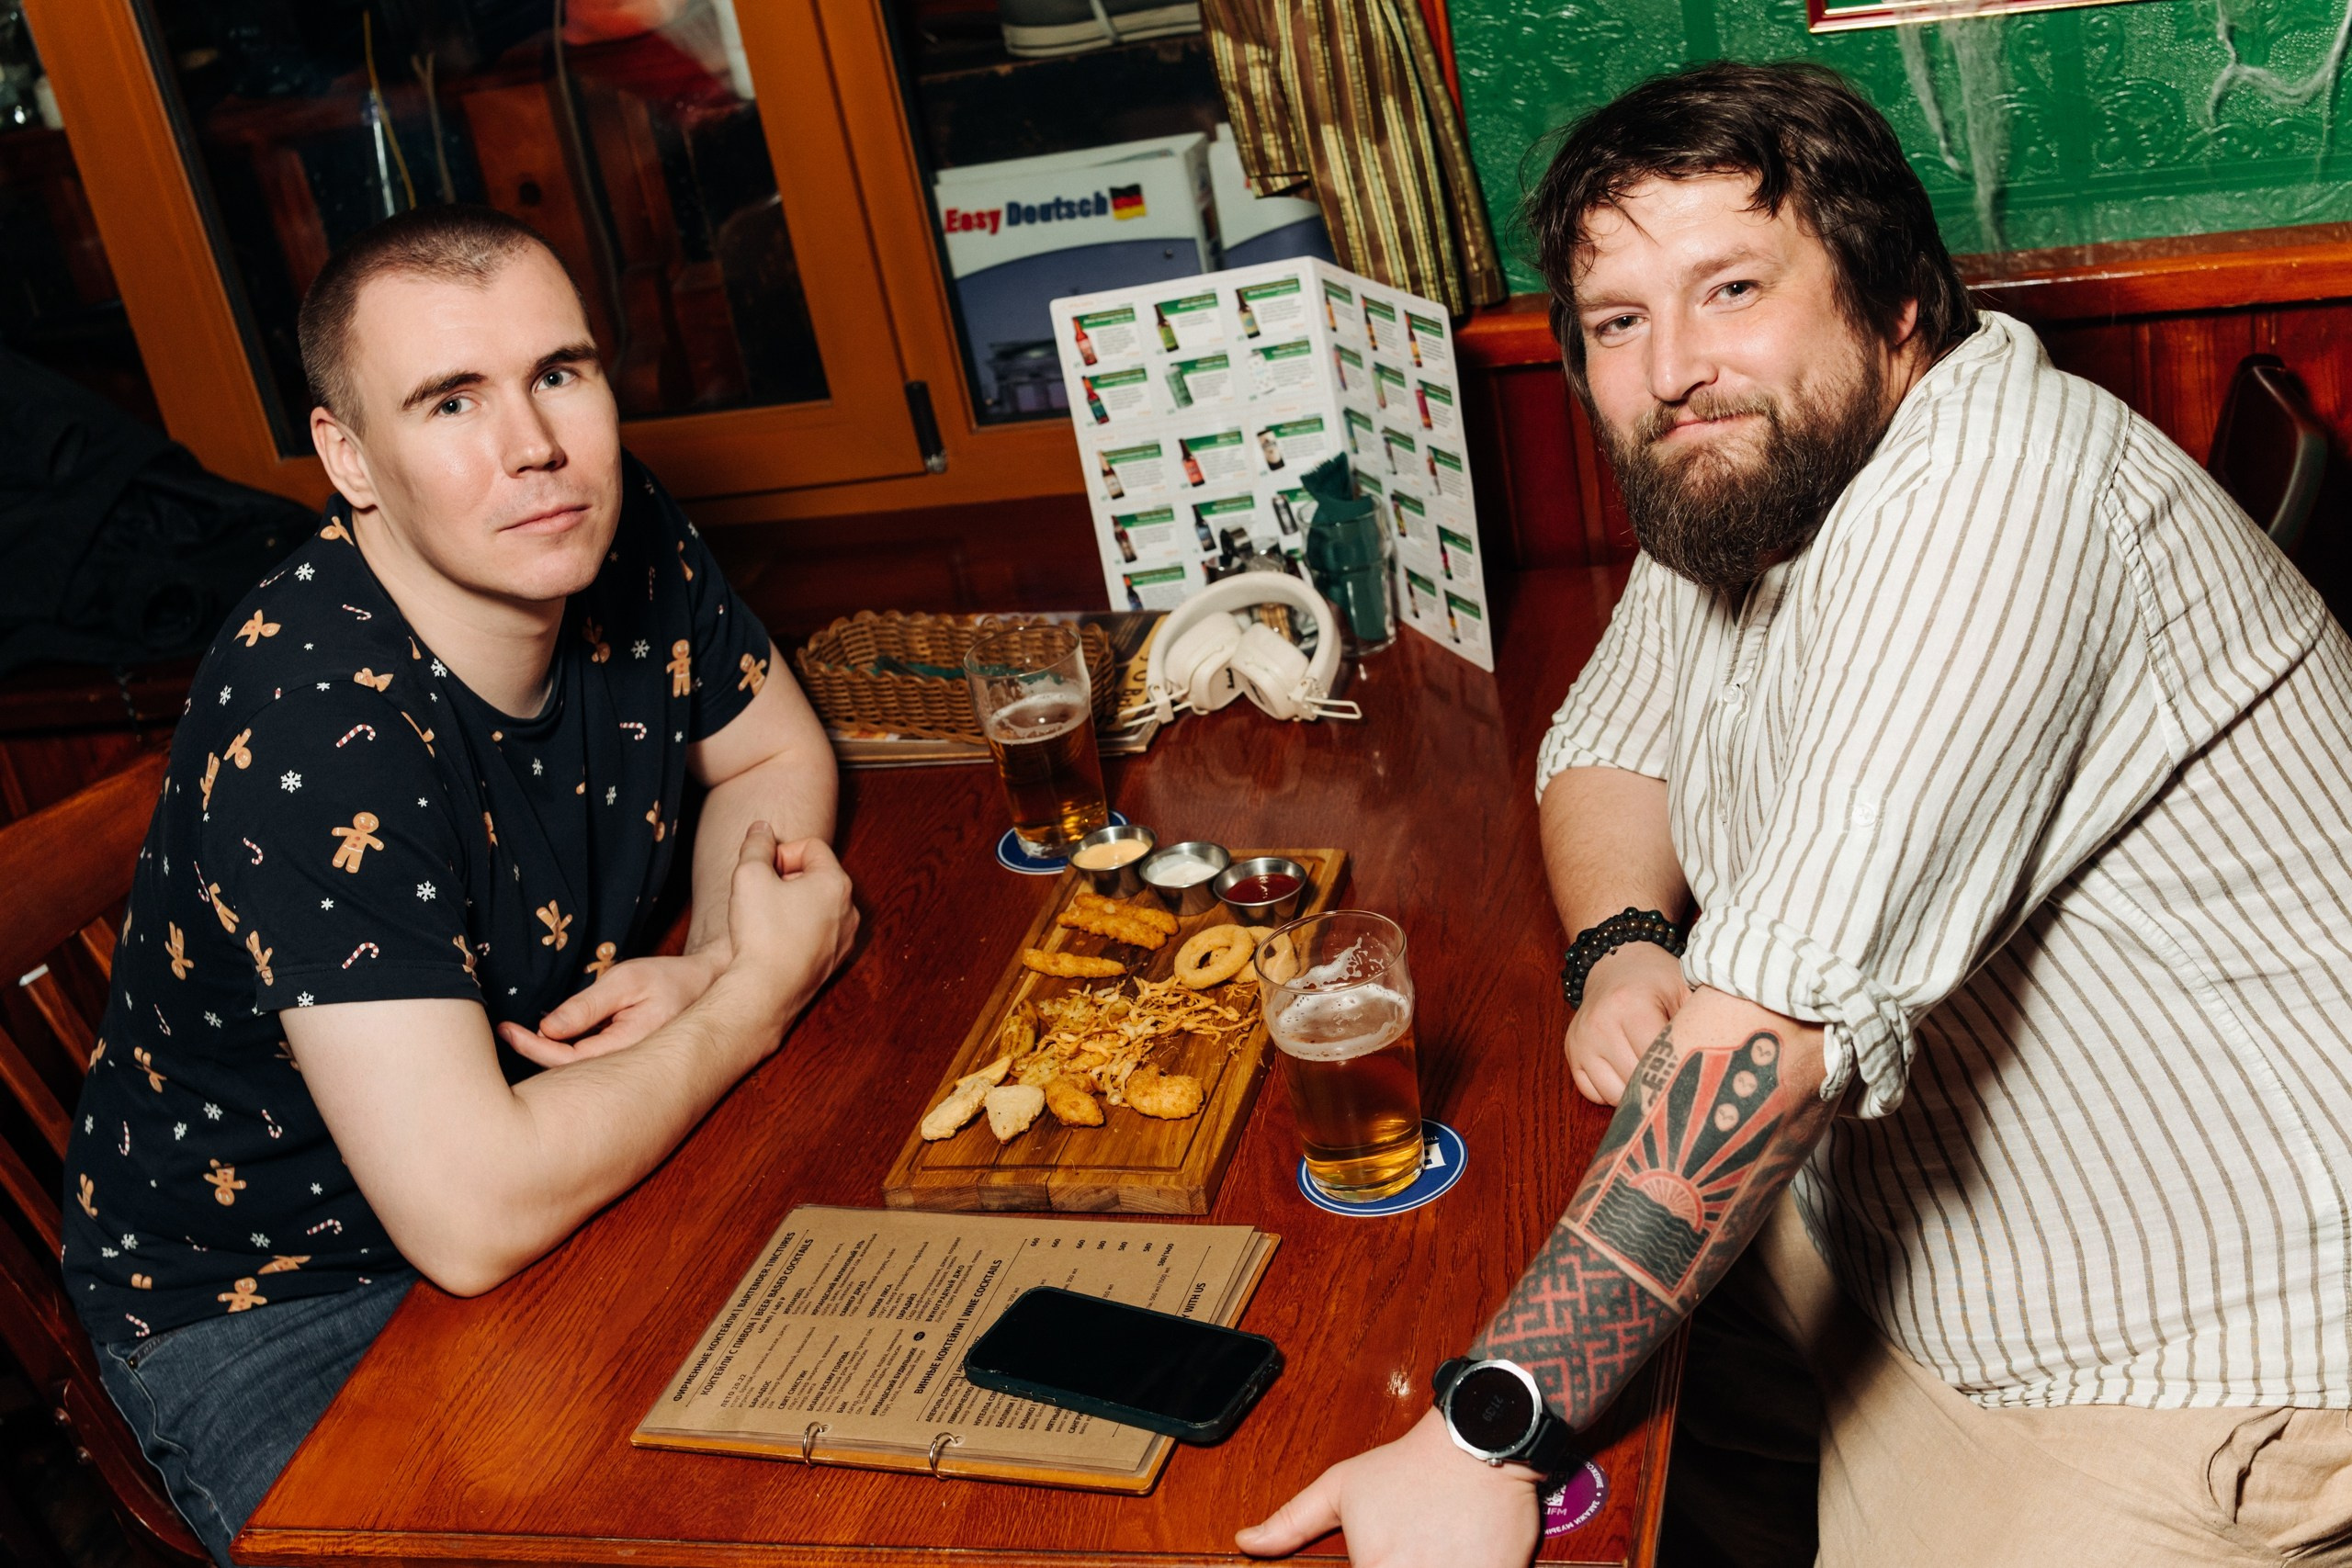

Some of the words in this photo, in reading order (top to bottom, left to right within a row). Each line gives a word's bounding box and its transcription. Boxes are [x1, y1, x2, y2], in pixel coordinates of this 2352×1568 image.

[945, 207, 1001, 235] Easy
[1006, 190, 1108, 227] Deutsch
[1029, 1237, 1041, 1247] 660
[1050, 1238, 1061, 1247] 660
[1075, 1239, 1086, 1248] 660
[1096, 1240, 1107, 1249] 580
[1117, 1241, 1128, 1250] 580
[1142, 1242, 1153, 1251] 580
[1156, 1243, 1175, 1266] 580/1400
[808, 1282, 838, 1315] ИРЛАНДСКИЙ
[831, 1250, 859, 1281] МАЛИНОВЫЙ
[854, 1239, 865, 1249] ЭЛЬ
[1065, 1274, 1075, 1282] 350
[782, 1287, 807, 1314] ИРЛАНДЕЦ
[838, 1295, 857, 1316] САММЕР
[852, 1280, 867, 1295] ДЖАЗ
[865, 1297, 885, 1317] ЧЕРНАЯ
[879, 1283, 894, 1297] ЛИСА
[894, 1292, 919, 1319] ПАРАДАЙЗ
[923, 1280, 957, 1321] ВИНОГРАДНЫЙ
[951, 1264, 966, 1278] ДЖО
[1006, 1293, 1016, 1302] 350
[1148, 1292, 1159, 1301] 560
[1182, 1294, 1201, 1313] WITH
[1193, 1282, 1206, 1292] US
[671, 1352, 712, 1401] ФИРМЕННЫЕ
[705, 1313, 740, 1350] КОКТЕЙЛИ
[736, 1268, 771, 1307] BARTENDER
[763, 1232, 797, 1267] TINCTURES
[698, 1355, 734, 1394] КОКТЕЙЛИ
[731, 1321, 757, 1348] ПИВОМ
[753, 1299, 773, 1315] BEER
[766, 1275, 789, 1297] BASED
[782, 1238, 814, 1274] COCKTAILS
[756, 1324, 768, 1333] 400
[772, 1301, 784, 1310] 480
[912, 1362, 941, 1393] ВИННЫЕ
[932, 1322, 966, 1360] КОКТЕЙЛИ
[961, 1298, 979, 1316] WINE
[972, 1259, 1003, 1297] COCKTAILS
[718, 1391, 735, 1406] ЛЕТО
[730, 1373, 747, 1389] 20.22
[776, 1395, 791, 1409] СВИТ
[786, 1370, 808, 1394] СИКСТИН
[806, 1391, 824, 1411] БЛАНШ
[819, 1372, 836, 1390] ВСЕМУ
[831, 1350, 851, 1371] ГОЛОВА
[868, 1379, 899, 1416] ИРЛАНДСКИЙ
[892, 1347, 919, 1379] БУДИЛЬНИК
[835, 1401, 849, 1413] БЫК
[924, 1397, 945, 1422] АПЕРОЛЬ
[939, 1375, 959, 1396] СПРИТЦ
[972, 1401, 993, 1426] НУТЕЛЛА
[994, 1402, 1015, 1427] БЕЛЛИНИ
[1017, 1406, 1036, 1428] БЛАНКО
[1043, 1407, 1063, 1431] МЯТНЫЙ
[1544, 1521, 1575, 1536] МУЗЫК
